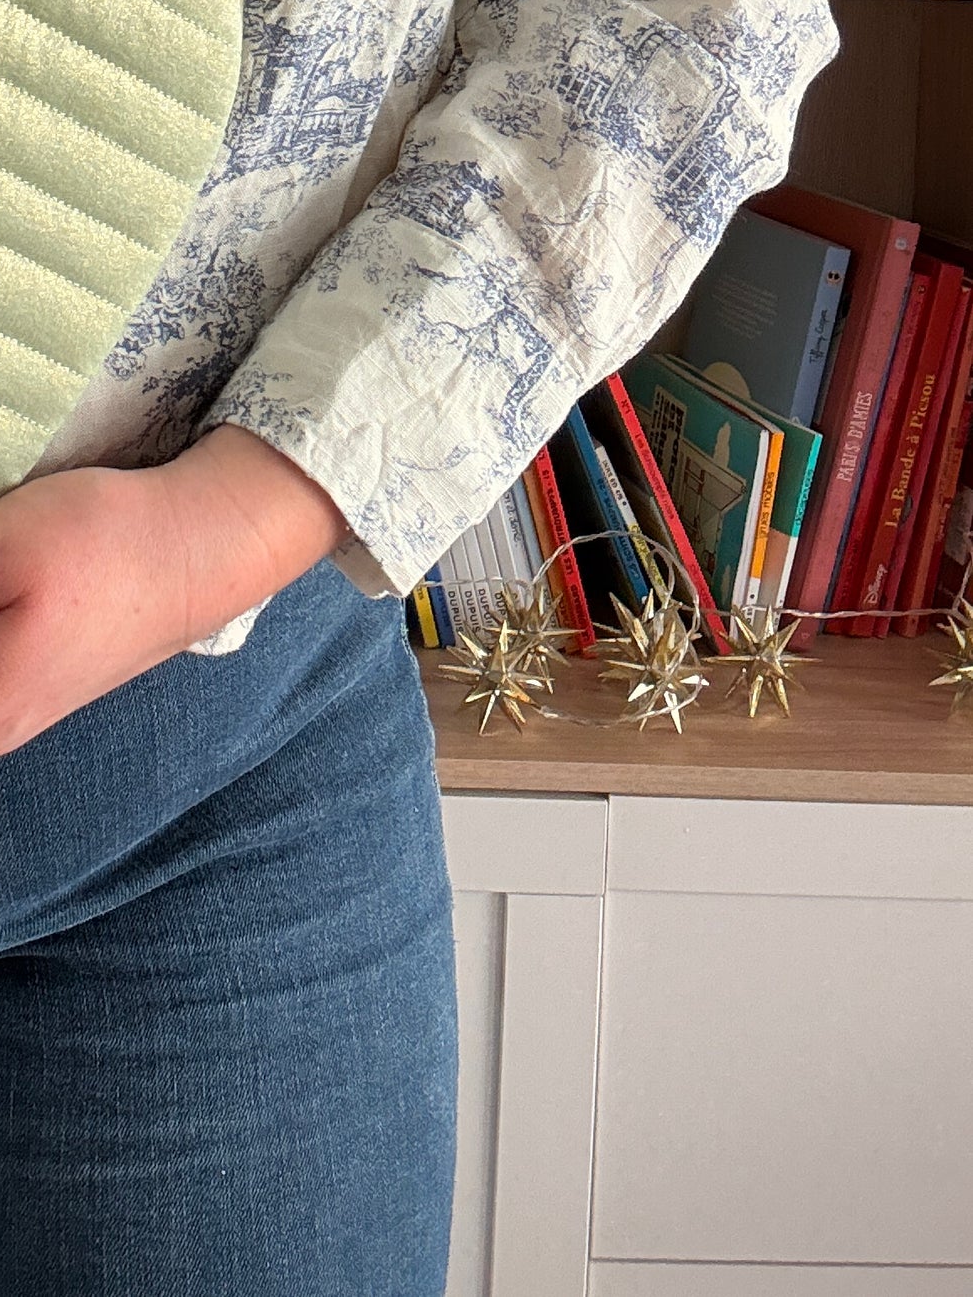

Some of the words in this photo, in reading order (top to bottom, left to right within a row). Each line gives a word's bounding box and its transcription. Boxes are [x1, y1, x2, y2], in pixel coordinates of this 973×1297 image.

[848, 391, 873, 439] D'AMIES
[910, 374, 935, 431] Picsou
[836, 443, 861, 481] PARIS
[905, 436, 920, 448] à
[891, 451, 916, 505] Bande
[885, 507, 902, 528] La
[448, 591, 463, 634] DUPUIS
[465, 590, 481, 632] DUPUIS
[478, 588, 494, 629] DUPUI
